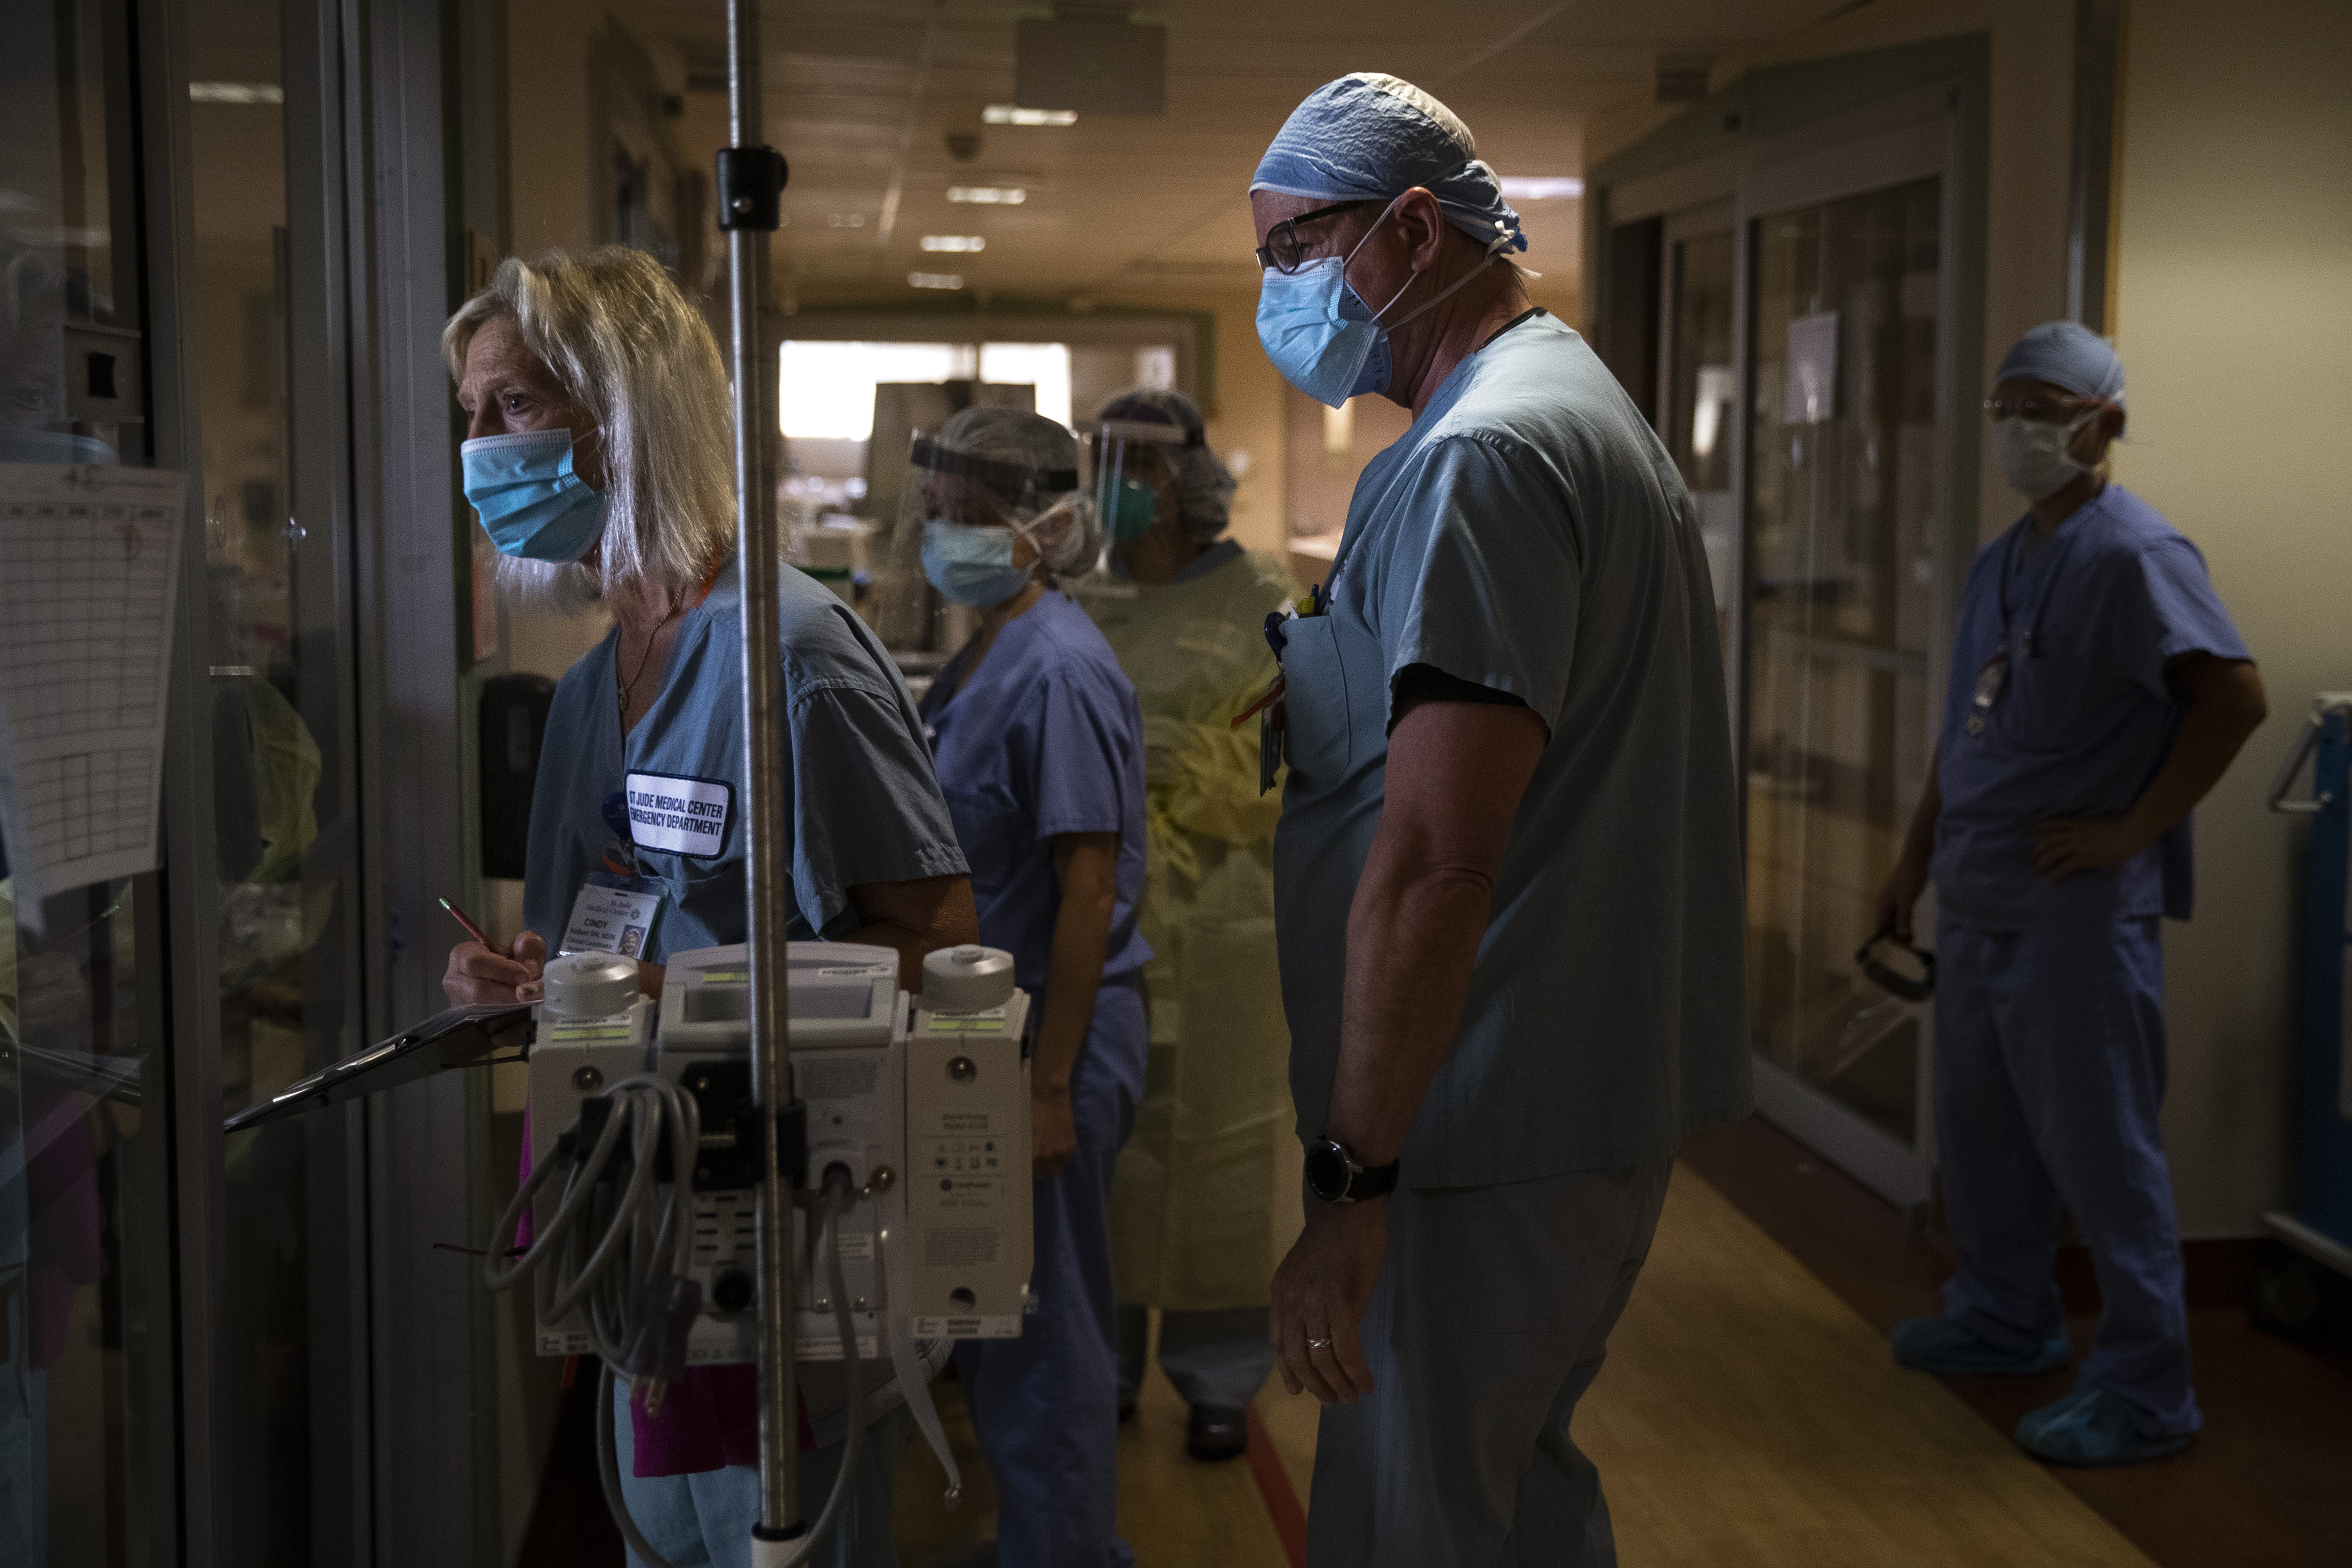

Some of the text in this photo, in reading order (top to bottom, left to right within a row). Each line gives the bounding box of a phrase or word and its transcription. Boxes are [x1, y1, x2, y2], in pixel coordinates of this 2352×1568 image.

[636, 792, 654, 808] JUDE
[655, 795, 685, 813] MEDICAL
[687, 800, 723, 819] CENTER
[630, 807, 722, 836] EMERGENCY DEPARTMENT
[584, 918, 609, 929] CINDY
